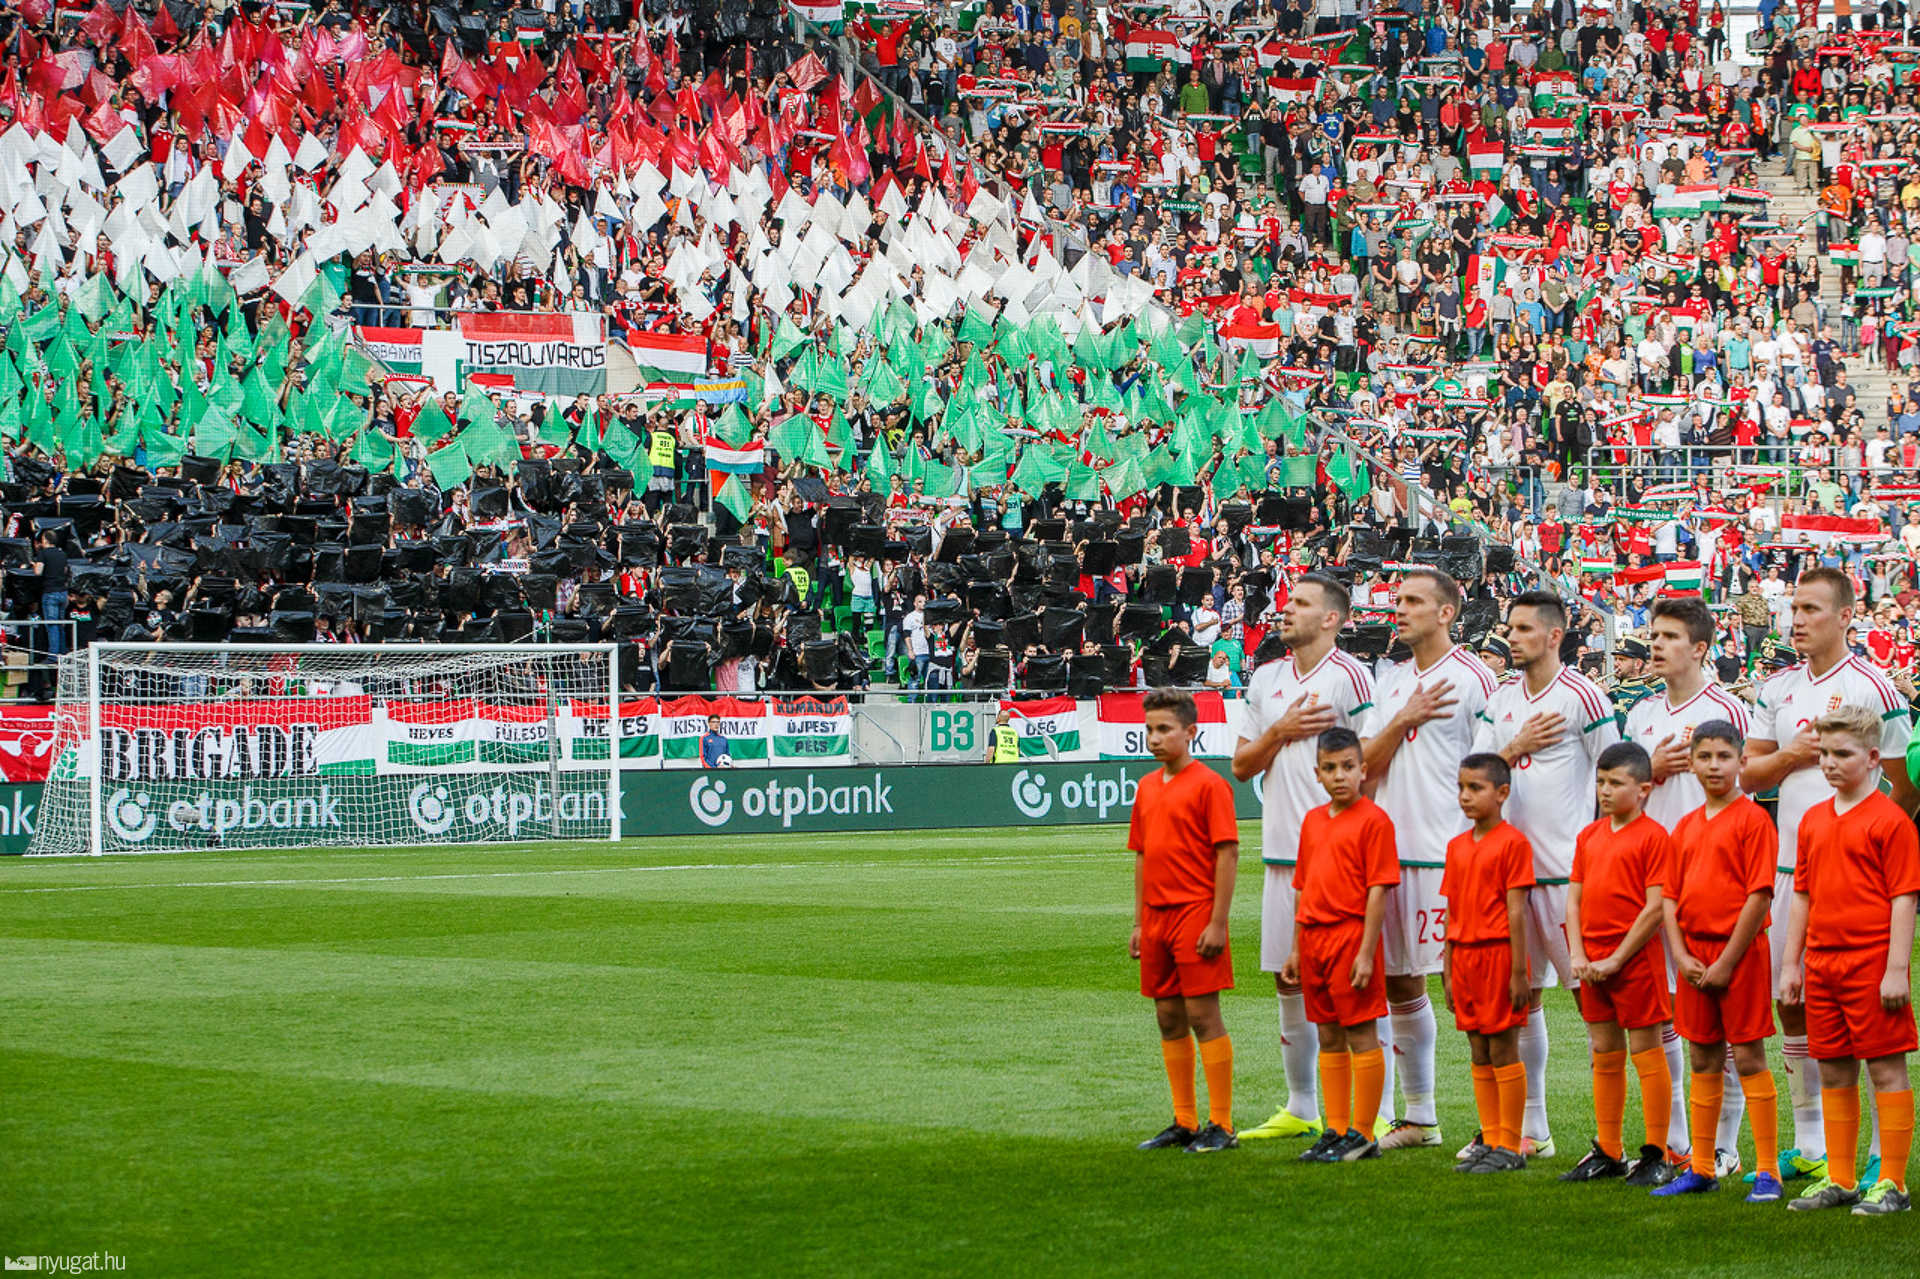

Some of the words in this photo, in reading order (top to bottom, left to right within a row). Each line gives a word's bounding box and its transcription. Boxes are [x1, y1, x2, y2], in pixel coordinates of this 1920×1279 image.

[465, 341, 605, 369] TISZAÚJVÁROS
[930, 710, 975, 751] B3
[1124, 730, 1207, 753] SIK
[100, 724, 319, 780] BRIGADE
[742, 773, 894, 828] otpbank
[1415, 908, 1447, 944] 23
